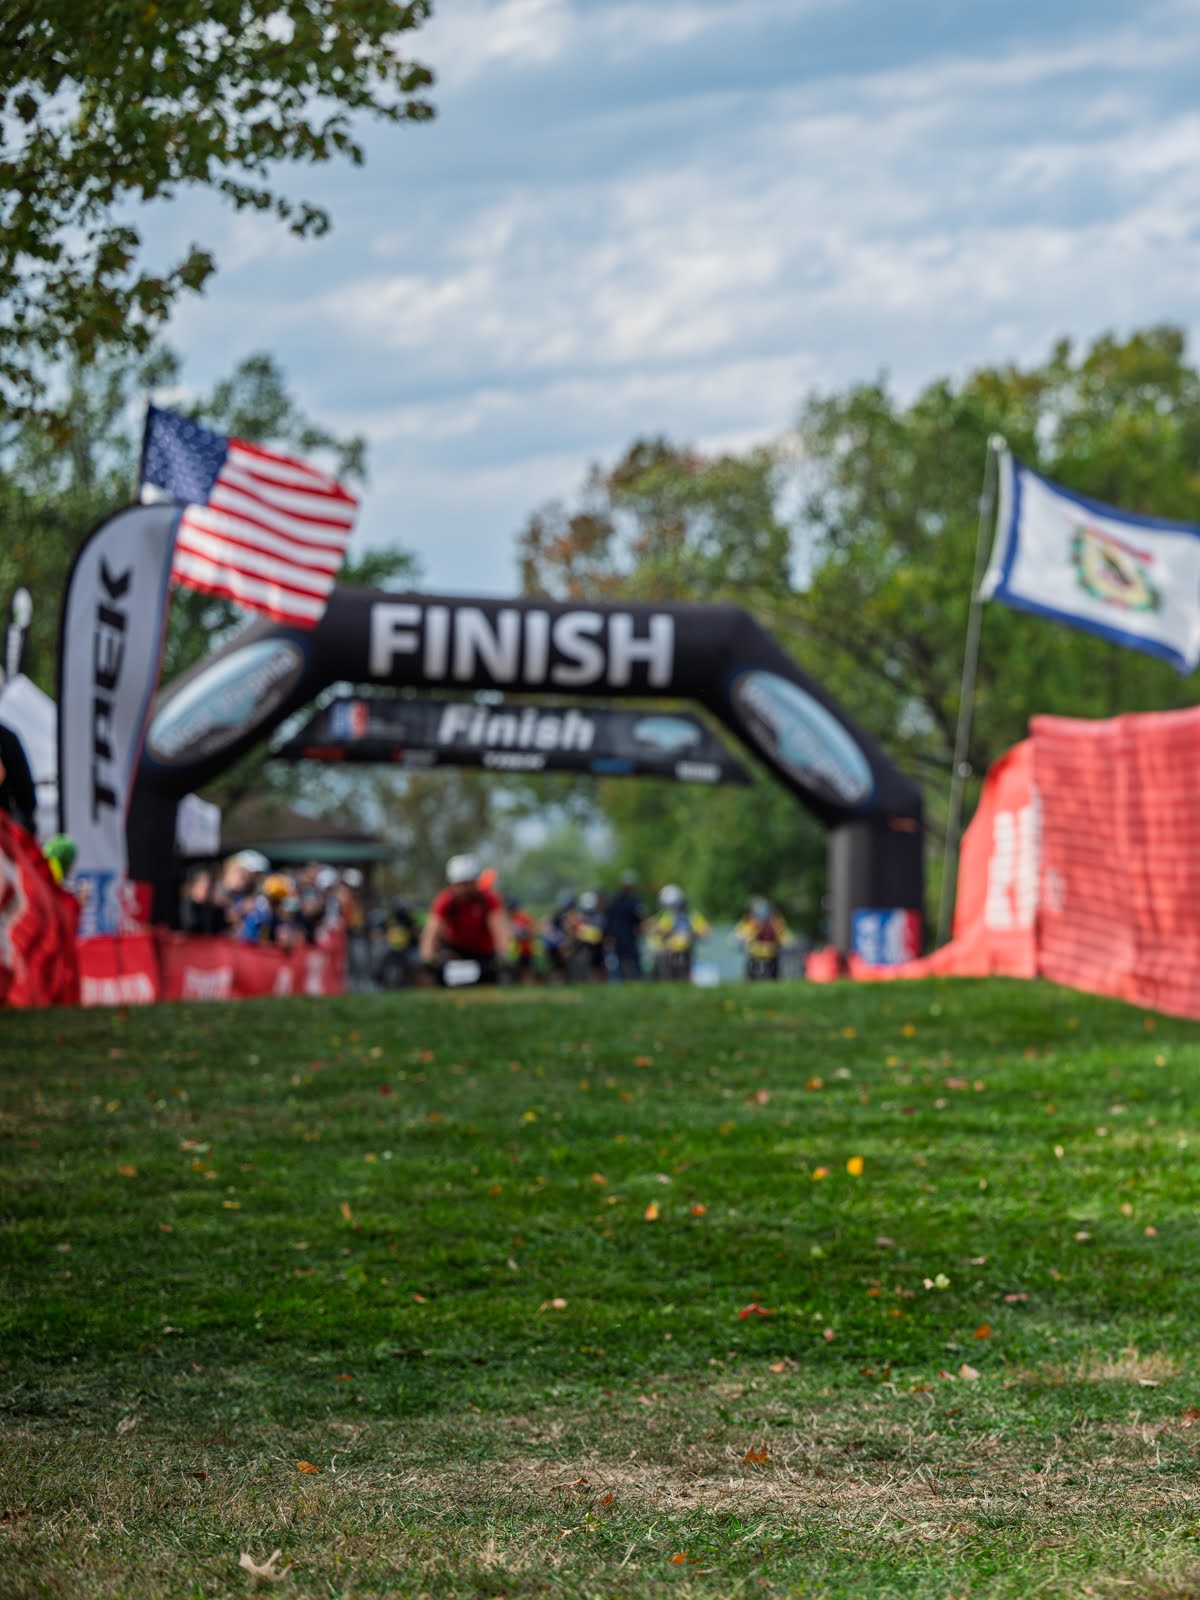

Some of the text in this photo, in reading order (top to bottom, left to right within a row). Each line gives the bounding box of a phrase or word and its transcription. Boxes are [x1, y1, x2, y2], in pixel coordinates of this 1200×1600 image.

[367, 601, 676, 688] FINISH
[91, 556, 133, 823] TREK
[436, 702, 597, 751] Finish
